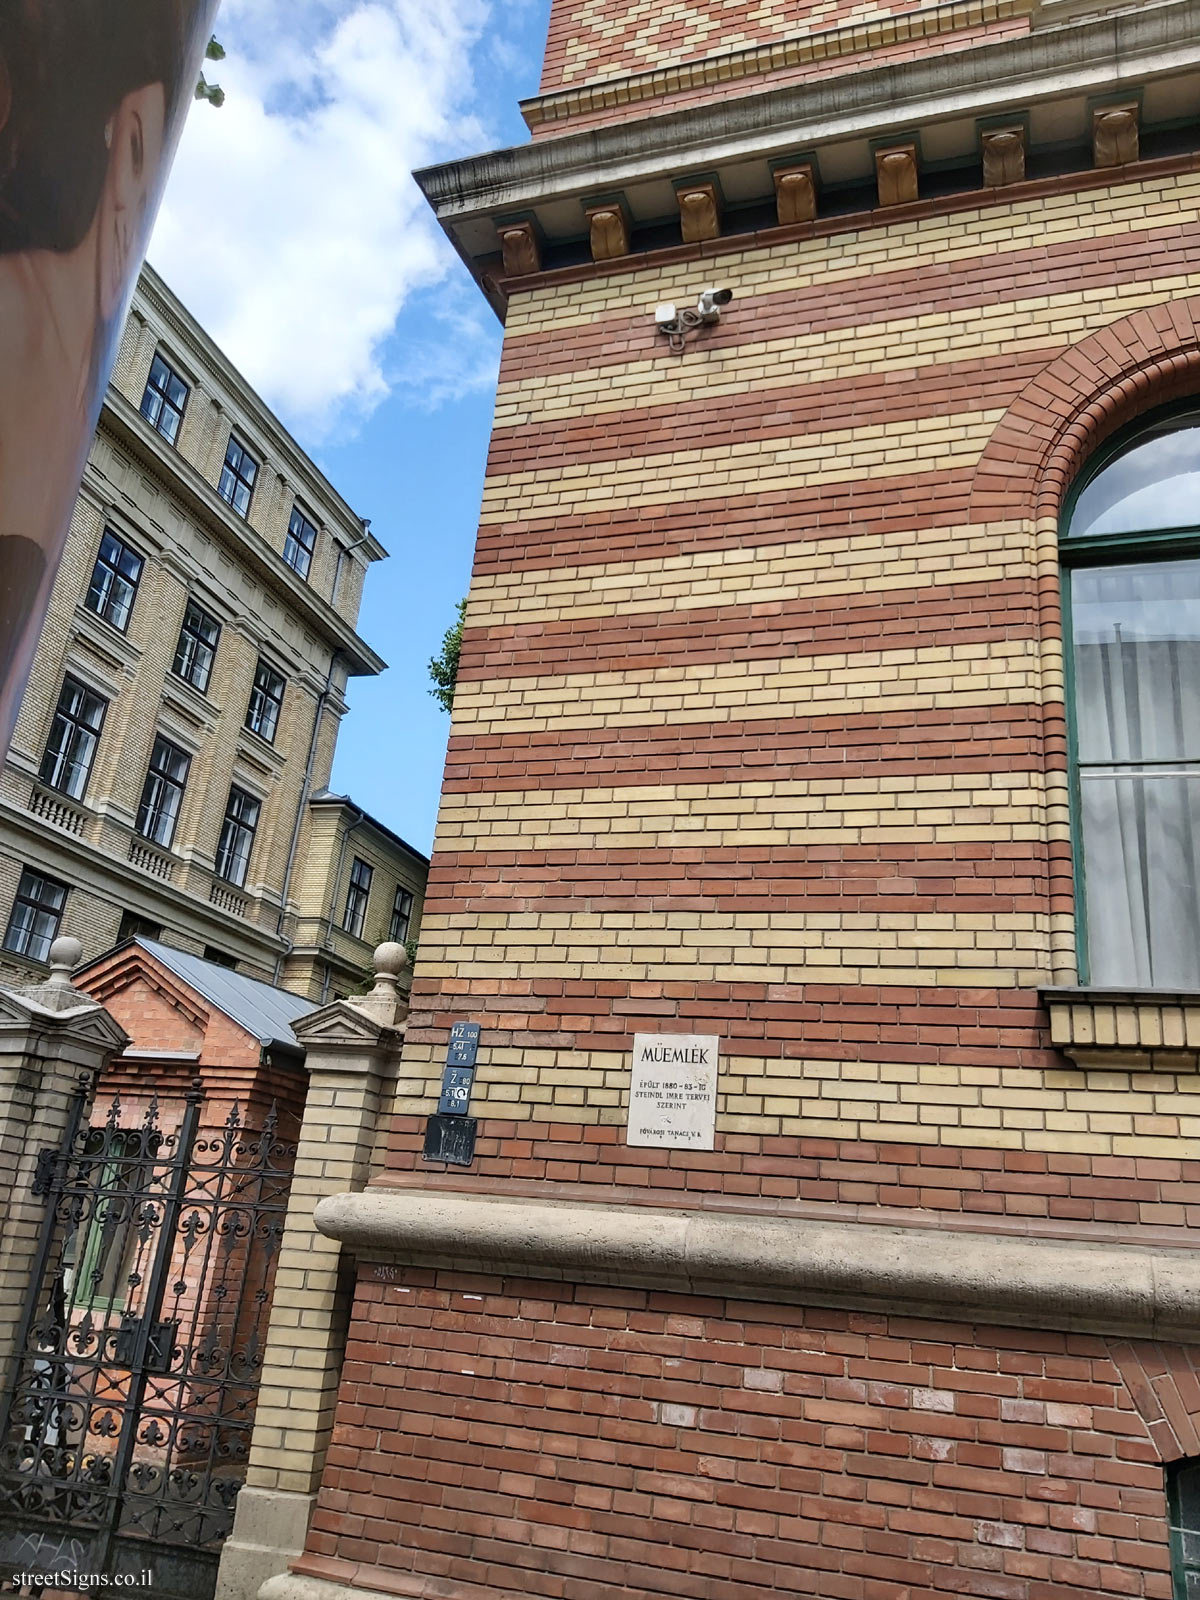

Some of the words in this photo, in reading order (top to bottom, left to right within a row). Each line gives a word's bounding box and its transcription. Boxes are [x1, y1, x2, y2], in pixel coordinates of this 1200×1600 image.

[467, 1031, 478, 1039] 100
[635, 1091, 663, 1099] STEINDL
[666, 1092, 683, 1100] IMRE
[686, 1093, 710, 1101] TERVEI
